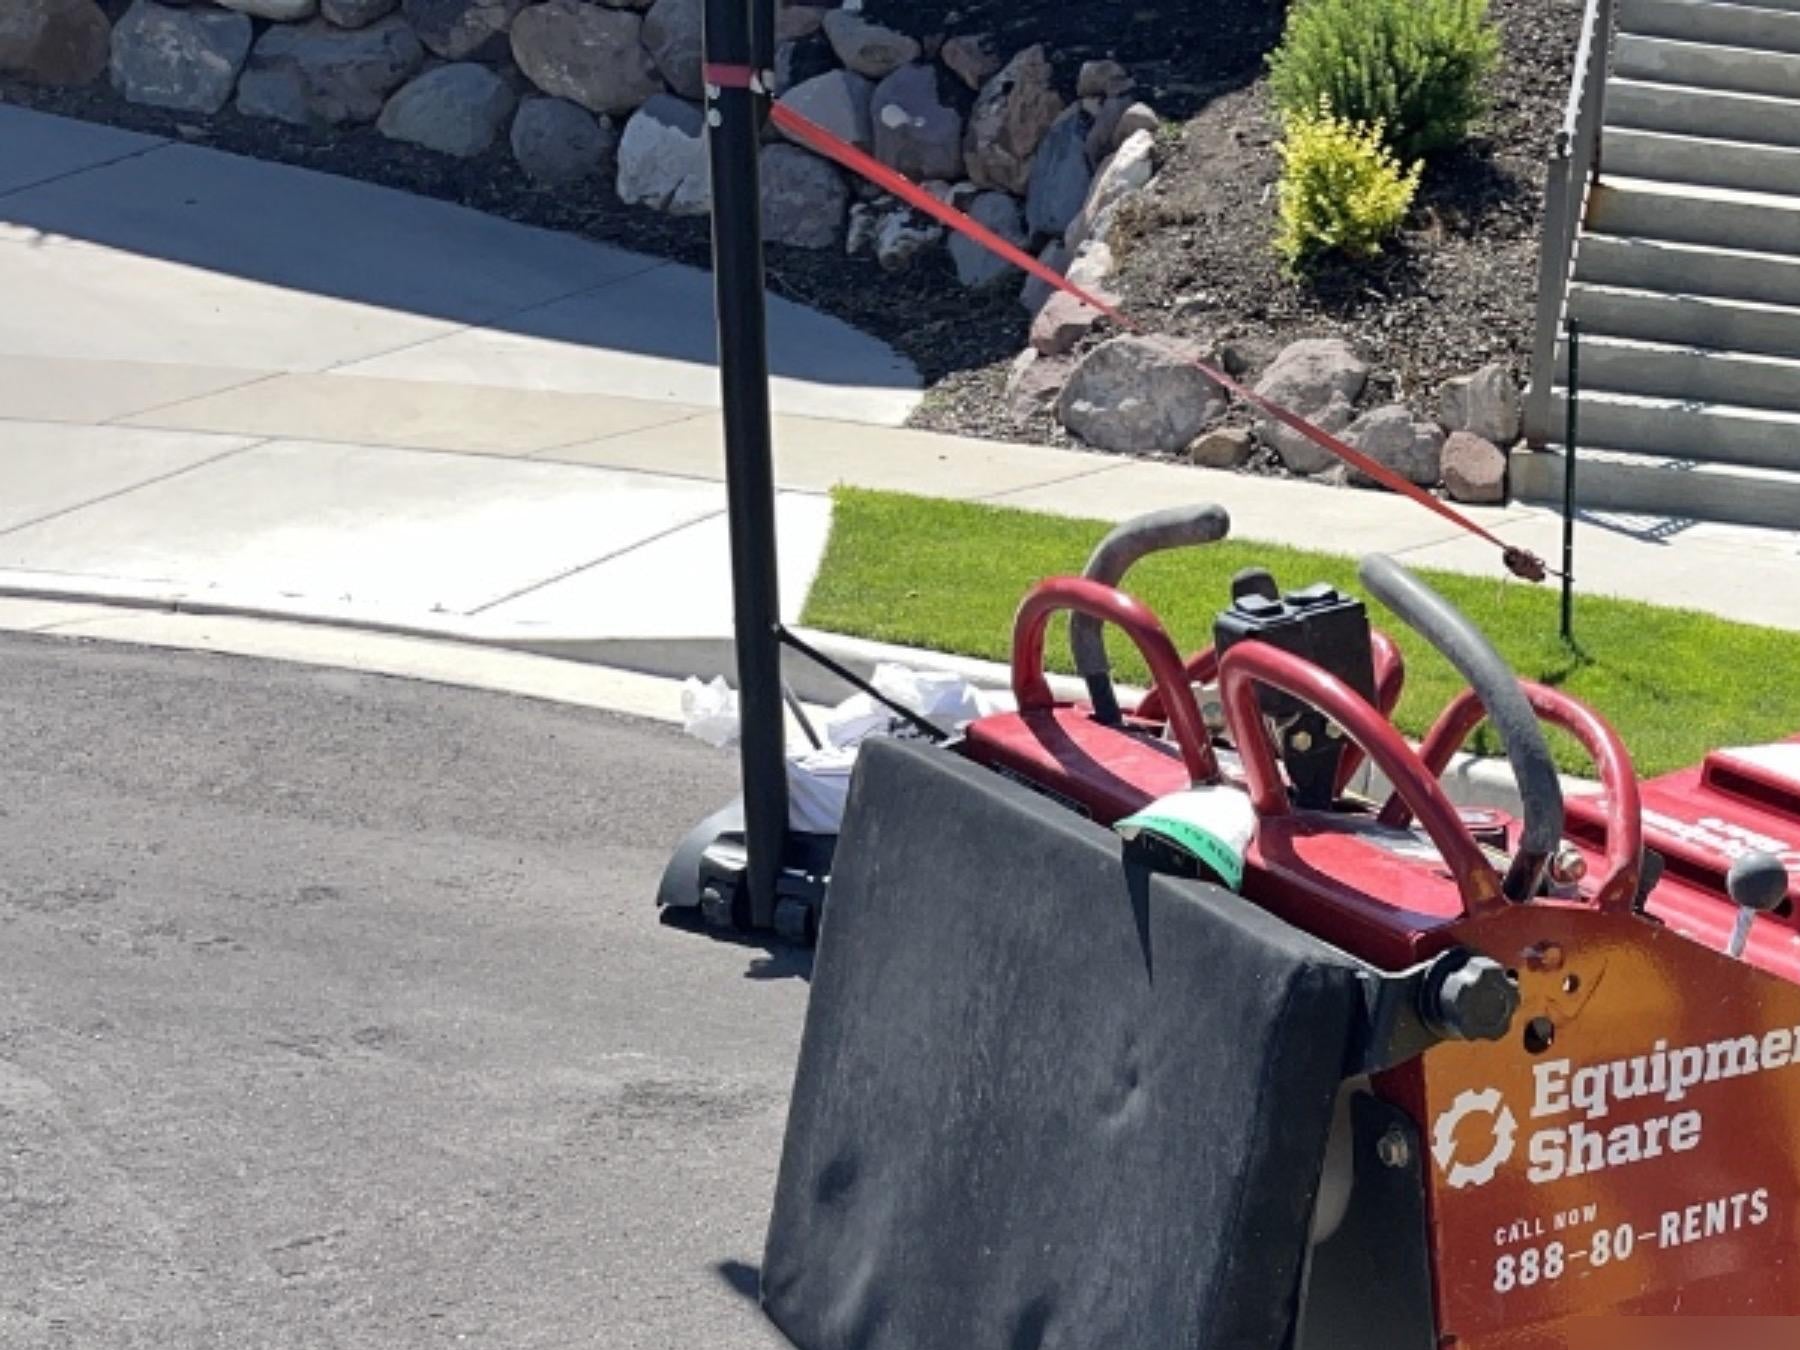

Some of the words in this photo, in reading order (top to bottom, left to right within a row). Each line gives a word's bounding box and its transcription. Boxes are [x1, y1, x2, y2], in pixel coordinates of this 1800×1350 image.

[1526, 1109, 1702, 1185] Share
[1493, 1190, 1769, 1293] 888-80-RENTS
[1494, 1217, 1546, 1246] CALL
[1553, 1202, 1598, 1231] NOW
